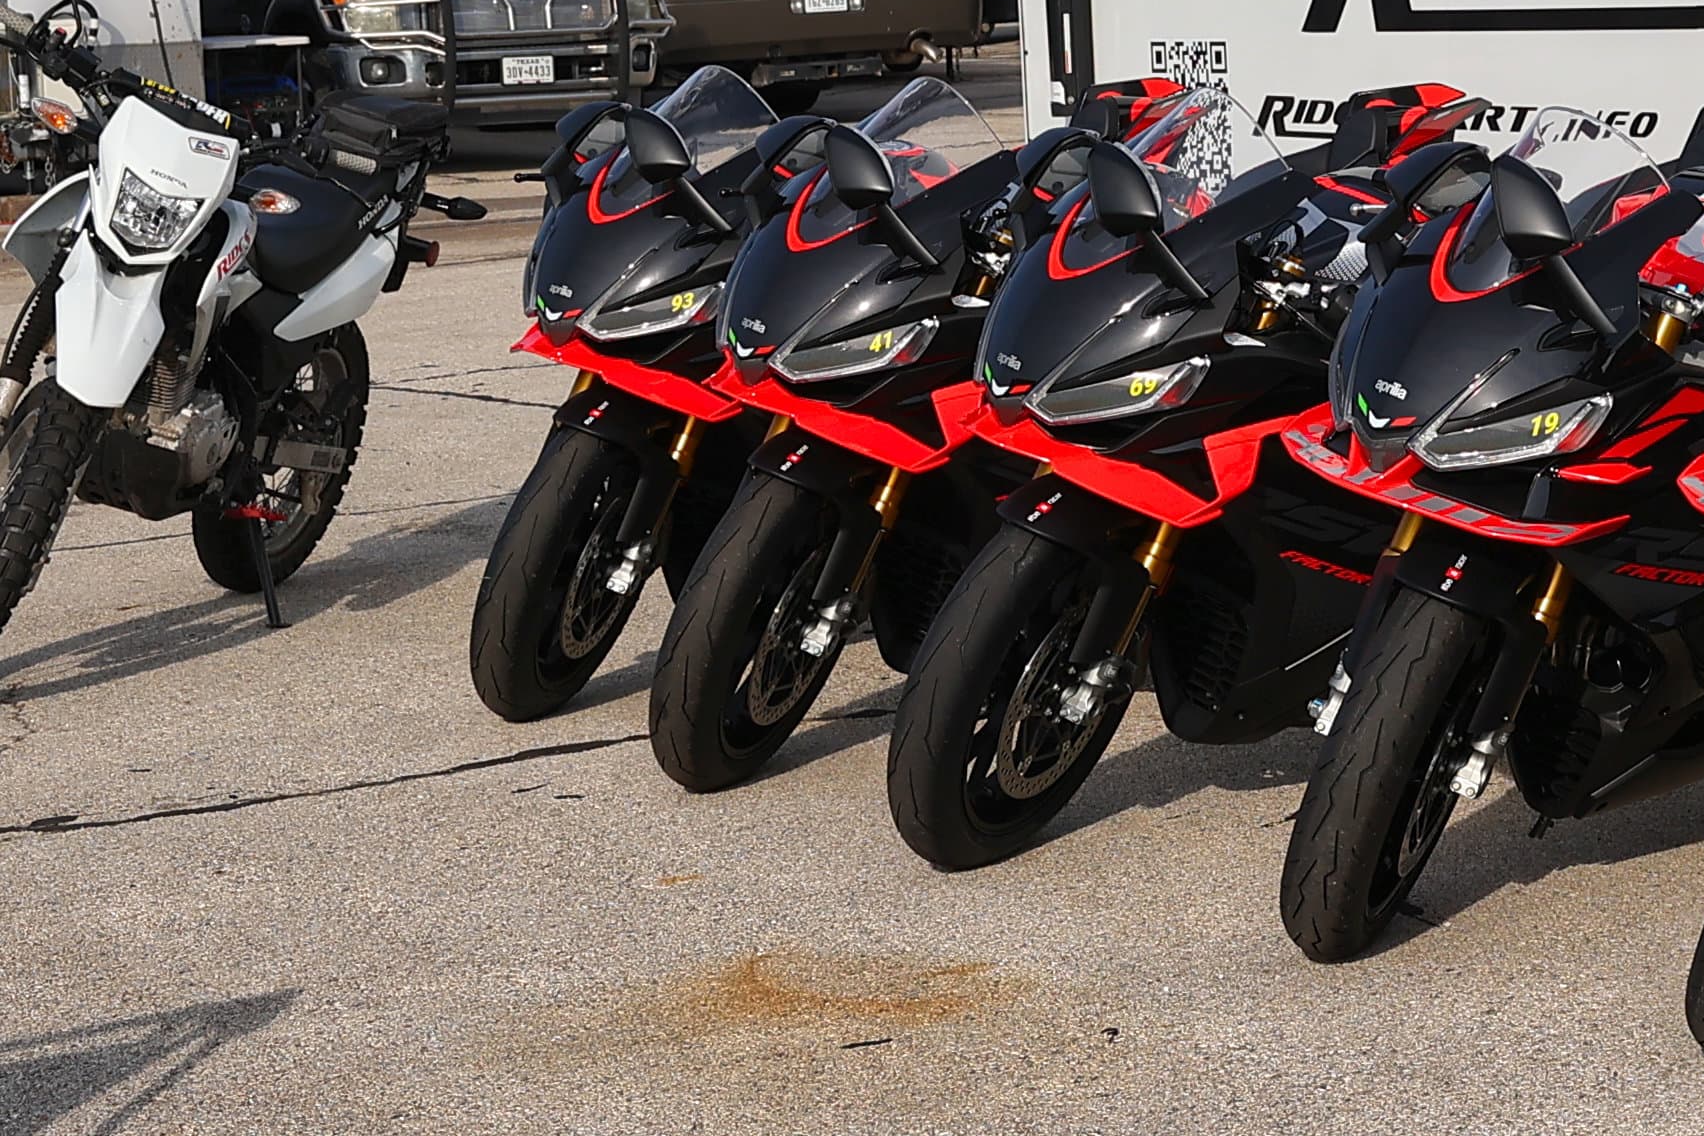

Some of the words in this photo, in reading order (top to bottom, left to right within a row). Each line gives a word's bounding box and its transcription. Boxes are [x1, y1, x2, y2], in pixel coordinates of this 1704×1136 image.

[671, 292, 694, 312] 93
[869, 331, 893, 353] 41
[997, 352, 1022, 371] aprilia
[1129, 378, 1157, 397] 69
[1375, 377, 1408, 401] aprilia
[1530, 412, 1559, 437] 19
